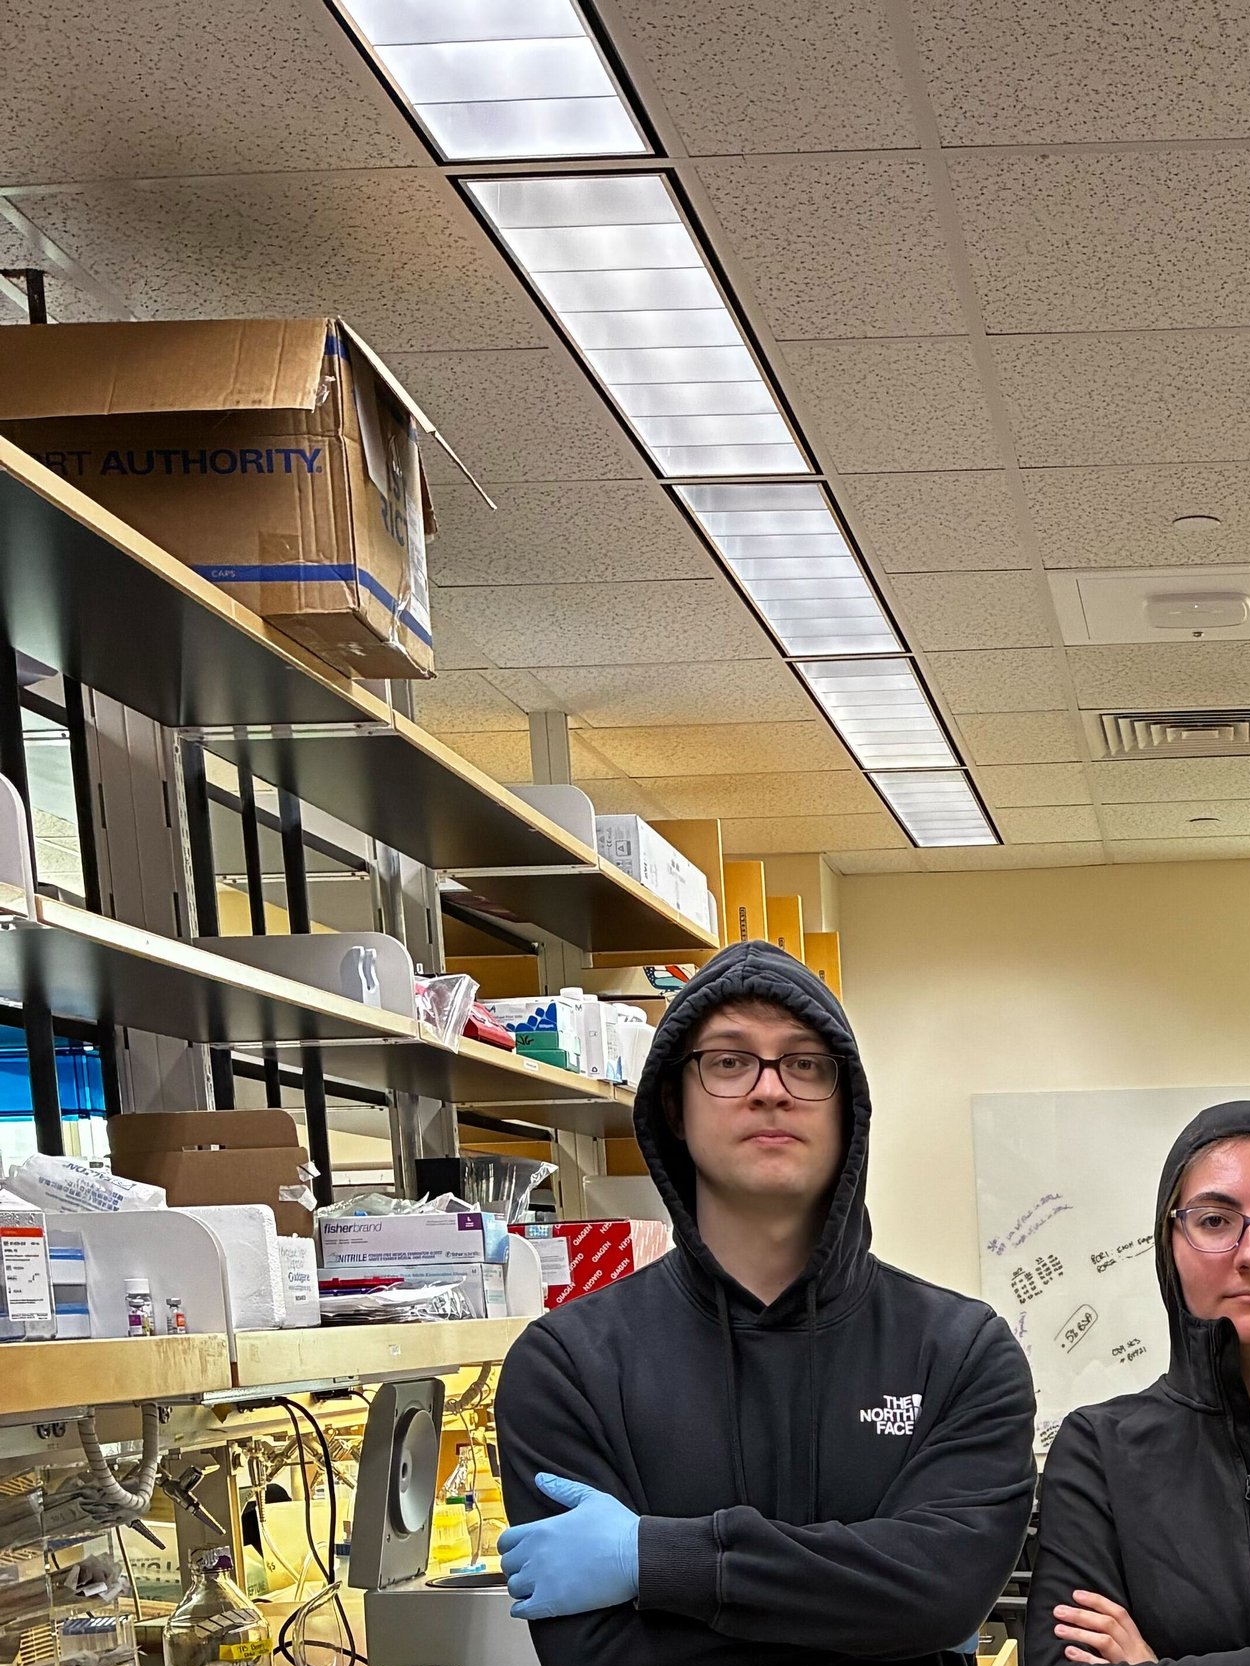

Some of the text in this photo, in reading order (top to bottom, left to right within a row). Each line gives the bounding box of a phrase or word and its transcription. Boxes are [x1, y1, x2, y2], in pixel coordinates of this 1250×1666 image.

[101, 448, 319, 475] AUTHORITY
[324, 1221, 382, 1234] fisherbrand
[573, 1223, 593, 1246] QIAGEN
[338, 1253, 367, 1263] NITRILE
[592, 1240, 612, 1263] QIAGEN
[611, 1257, 630, 1280] QIAGEN
[582, 1269, 603, 1291] QIAGEN
[556, 1281, 576, 1304] QIAGEN
[883, 1394, 912, 1410] THE
[860, 1407, 914, 1422] NORTH
[877, 1421, 915, 1435] FACE
